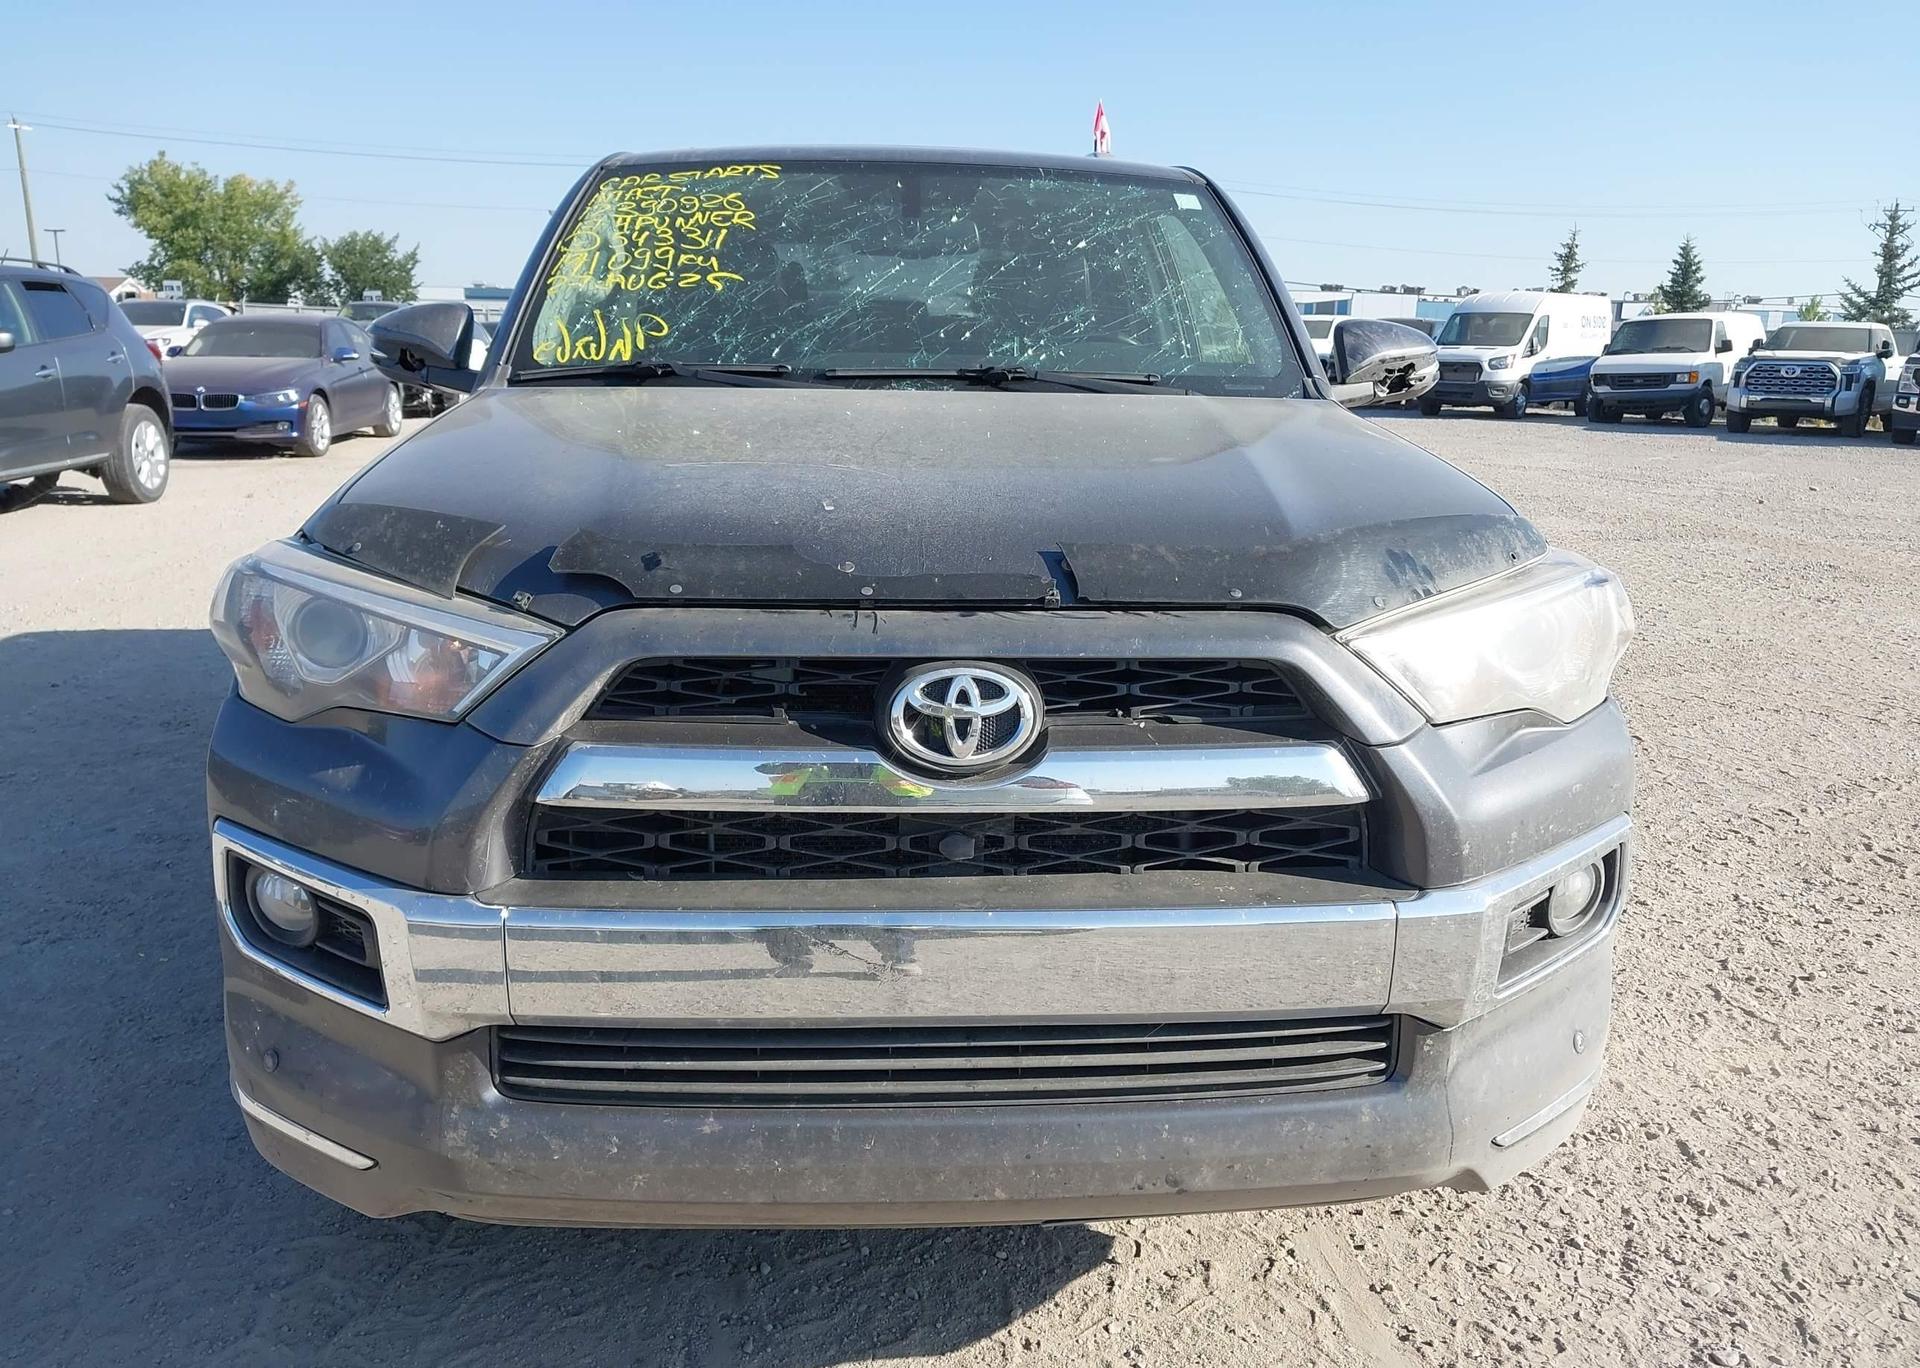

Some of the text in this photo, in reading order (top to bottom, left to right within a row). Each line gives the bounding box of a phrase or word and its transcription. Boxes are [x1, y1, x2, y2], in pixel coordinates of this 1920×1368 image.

[600, 164, 783, 190] CAR STARTS
[1581, 315, 1592, 328] ON
